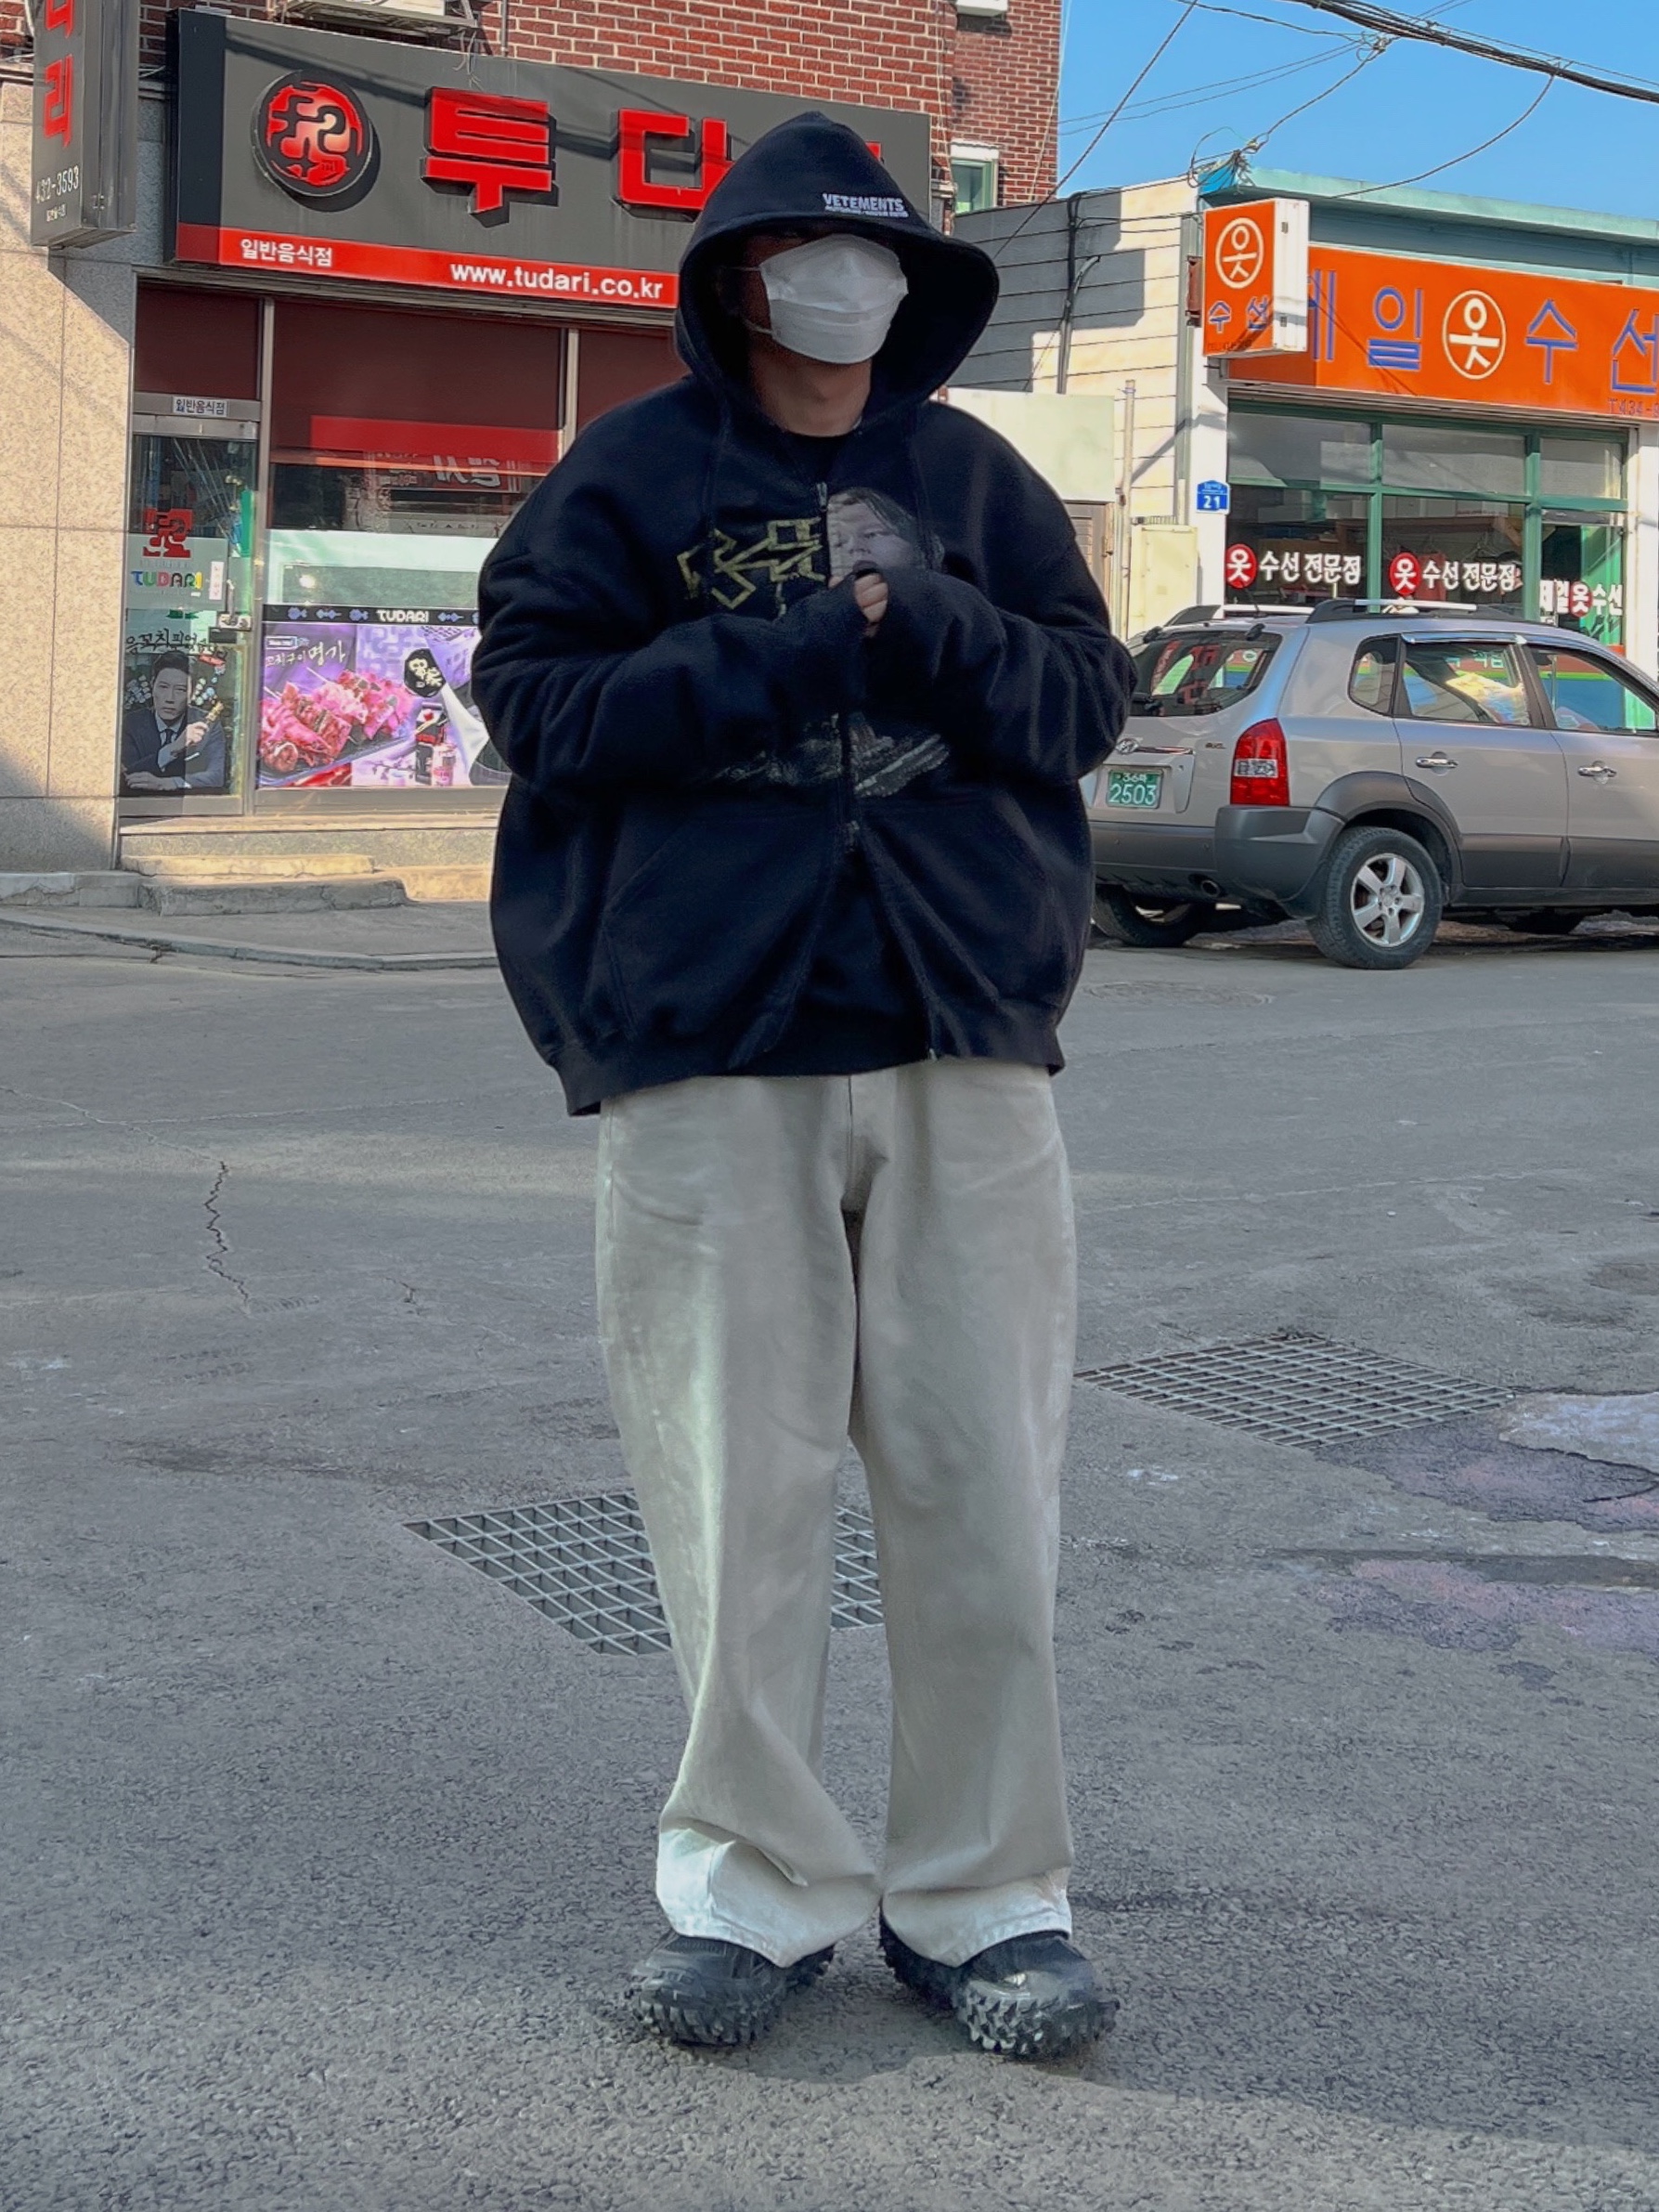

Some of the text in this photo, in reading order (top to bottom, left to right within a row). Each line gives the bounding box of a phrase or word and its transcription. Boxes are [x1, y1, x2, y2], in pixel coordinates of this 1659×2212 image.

[823, 192, 904, 212] VETEMENTS
[240, 239, 333, 267] 일반음식점
[449, 263, 664, 299] www.tudari.co.kr
[175, 398, 225, 416] 일반음식점
[1203, 495, 1221, 509] 21
[1259, 550, 1301, 582] 수선
[1303, 553, 1362, 584] 전문점
[1422, 559, 1459, 590] 수선
[1462, 562, 1516, 592] 전문점
[131, 570, 203, 591] TUDARI
[376, 609, 430, 624] TUDARI
[1108, 784, 1158, 806] 2503
